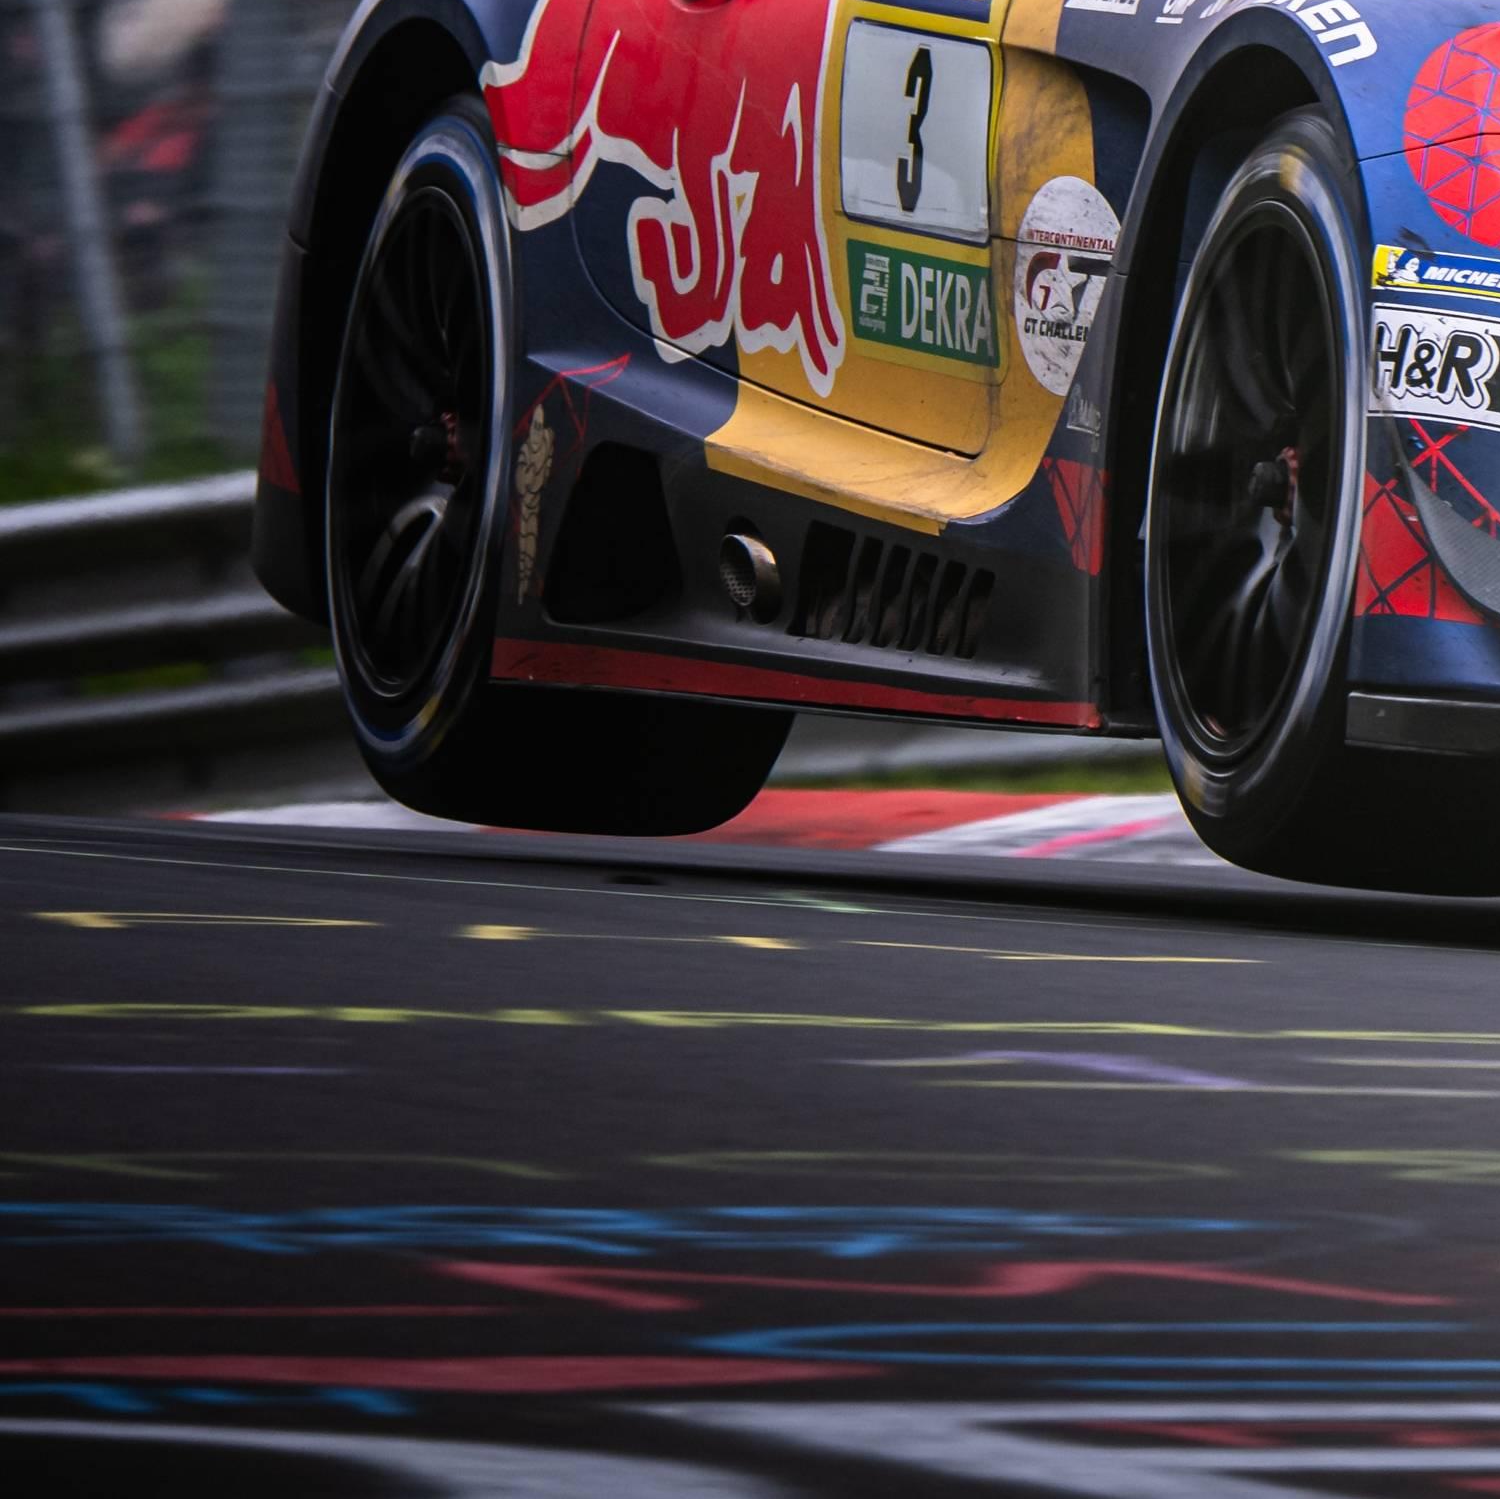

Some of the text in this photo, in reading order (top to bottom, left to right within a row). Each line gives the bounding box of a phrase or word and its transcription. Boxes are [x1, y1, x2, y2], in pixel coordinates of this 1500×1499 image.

[897, 46, 933, 213] 3
[901, 263, 995, 357] DEKRA
[1024, 318, 1038, 334] GT
[1375, 323, 1488, 403] H&R
